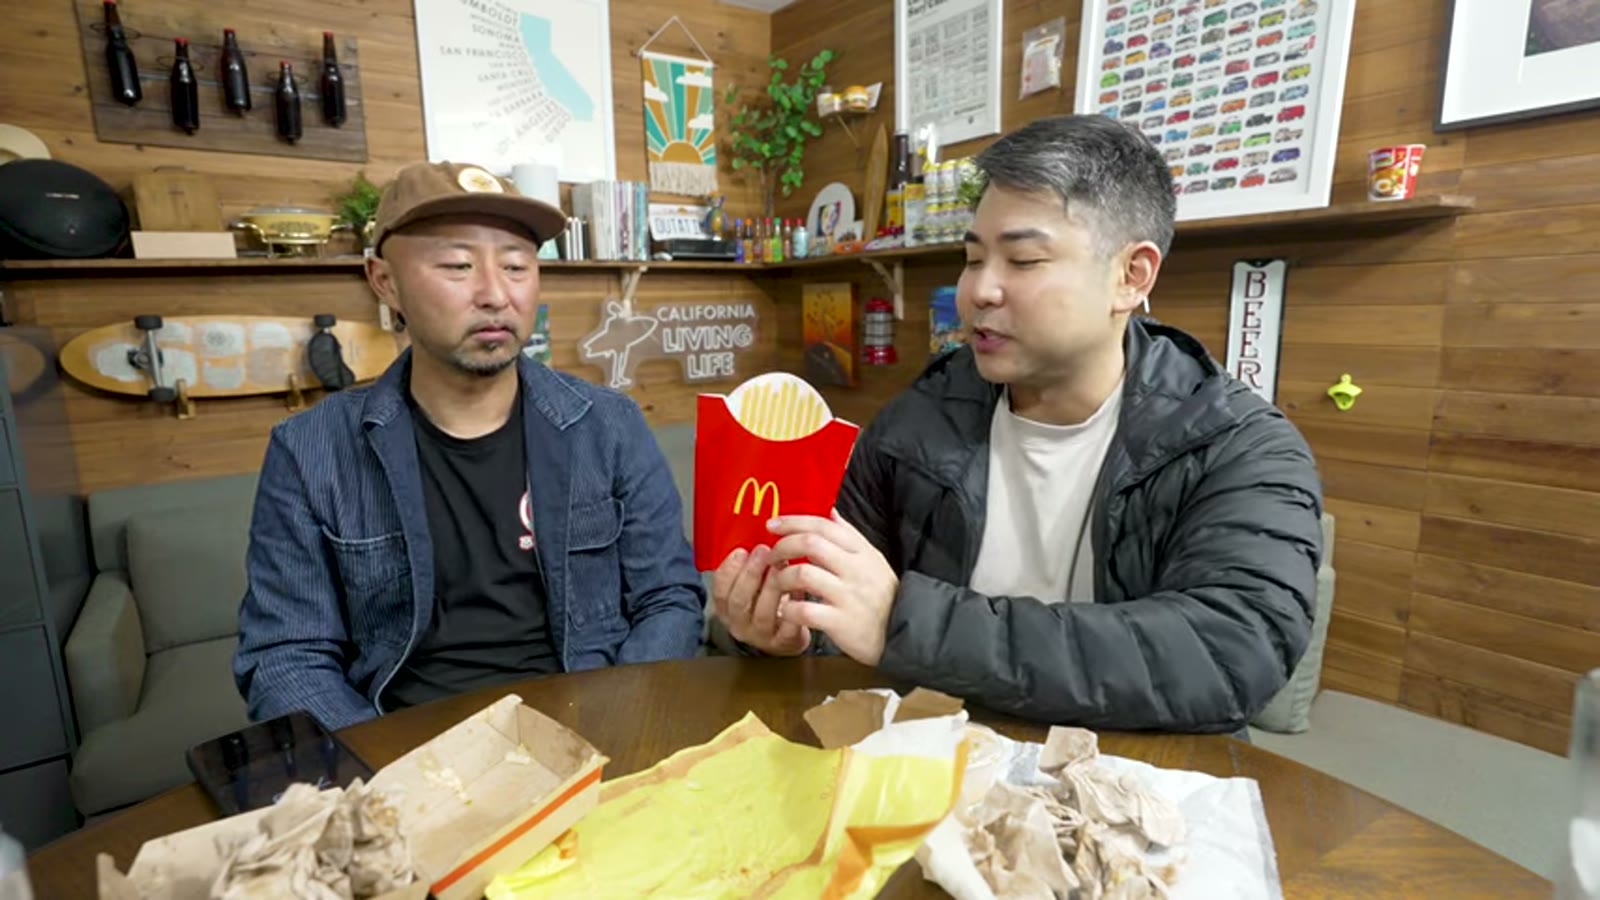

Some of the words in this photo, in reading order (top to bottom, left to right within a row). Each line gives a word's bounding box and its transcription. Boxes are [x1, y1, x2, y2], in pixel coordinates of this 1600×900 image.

[472, 23, 519, 43] SONOMA
[440, 45, 462, 56] SAN
[466, 47, 528, 61] FRANCISCO
[654, 217, 701, 235] OUTATI
[657, 304, 755, 321] CALIFORNIA
[663, 324, 753, 353] LIVING
[1236, 270, 1268, 389] BEER
[688, 352, 734, 379] LIFE
